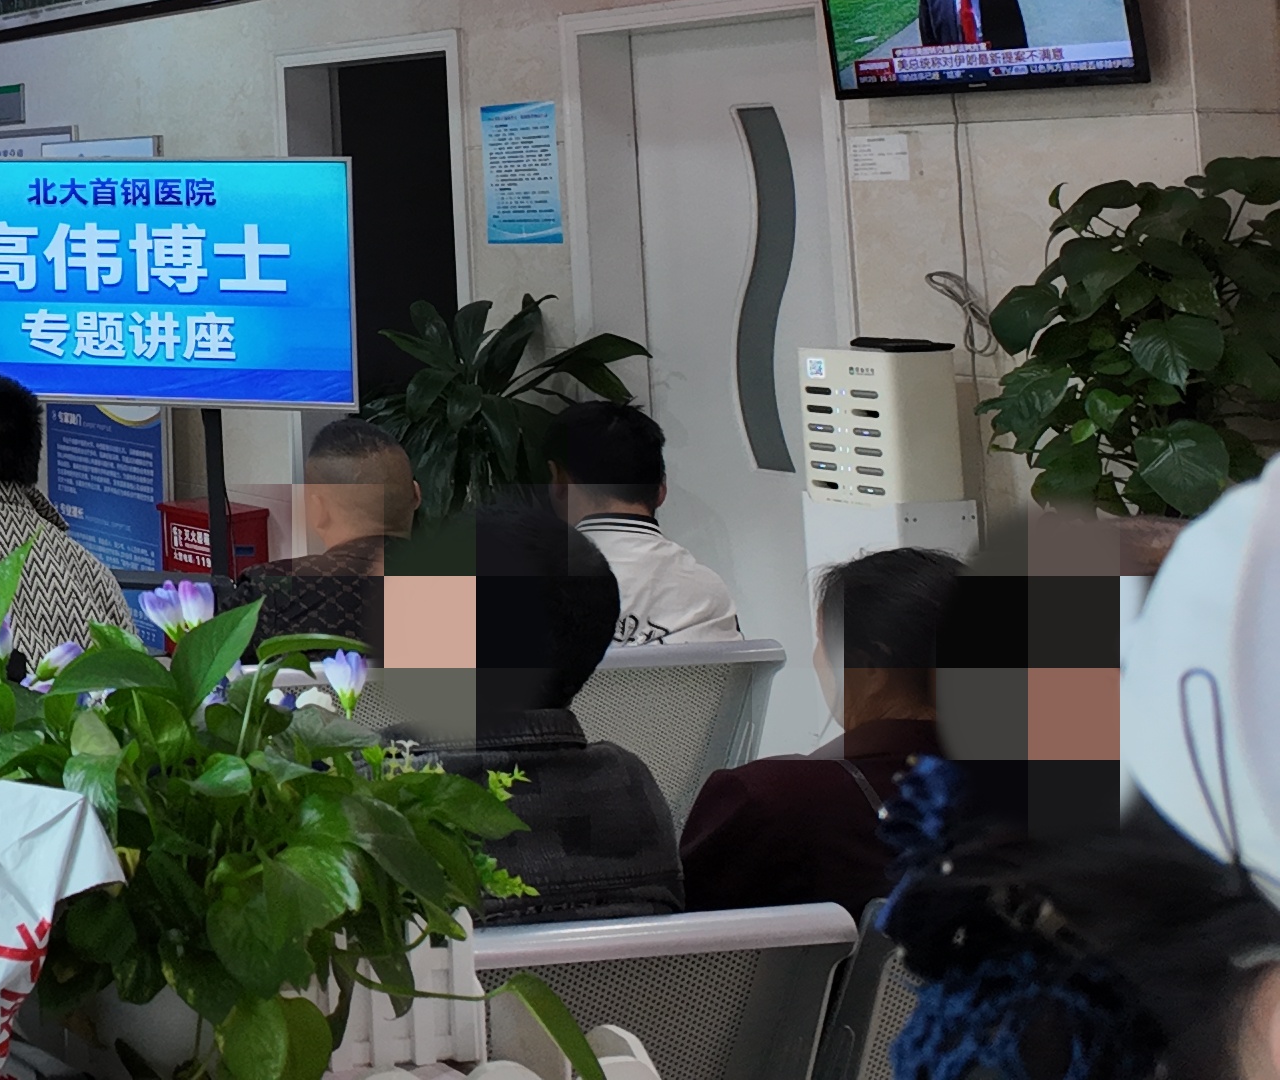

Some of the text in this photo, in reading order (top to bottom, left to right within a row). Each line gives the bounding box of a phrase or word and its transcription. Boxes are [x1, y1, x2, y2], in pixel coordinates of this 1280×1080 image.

[27, 177, 217, 208] 北大首钢医院
[21, 308, 237, 362] 专题讲座
